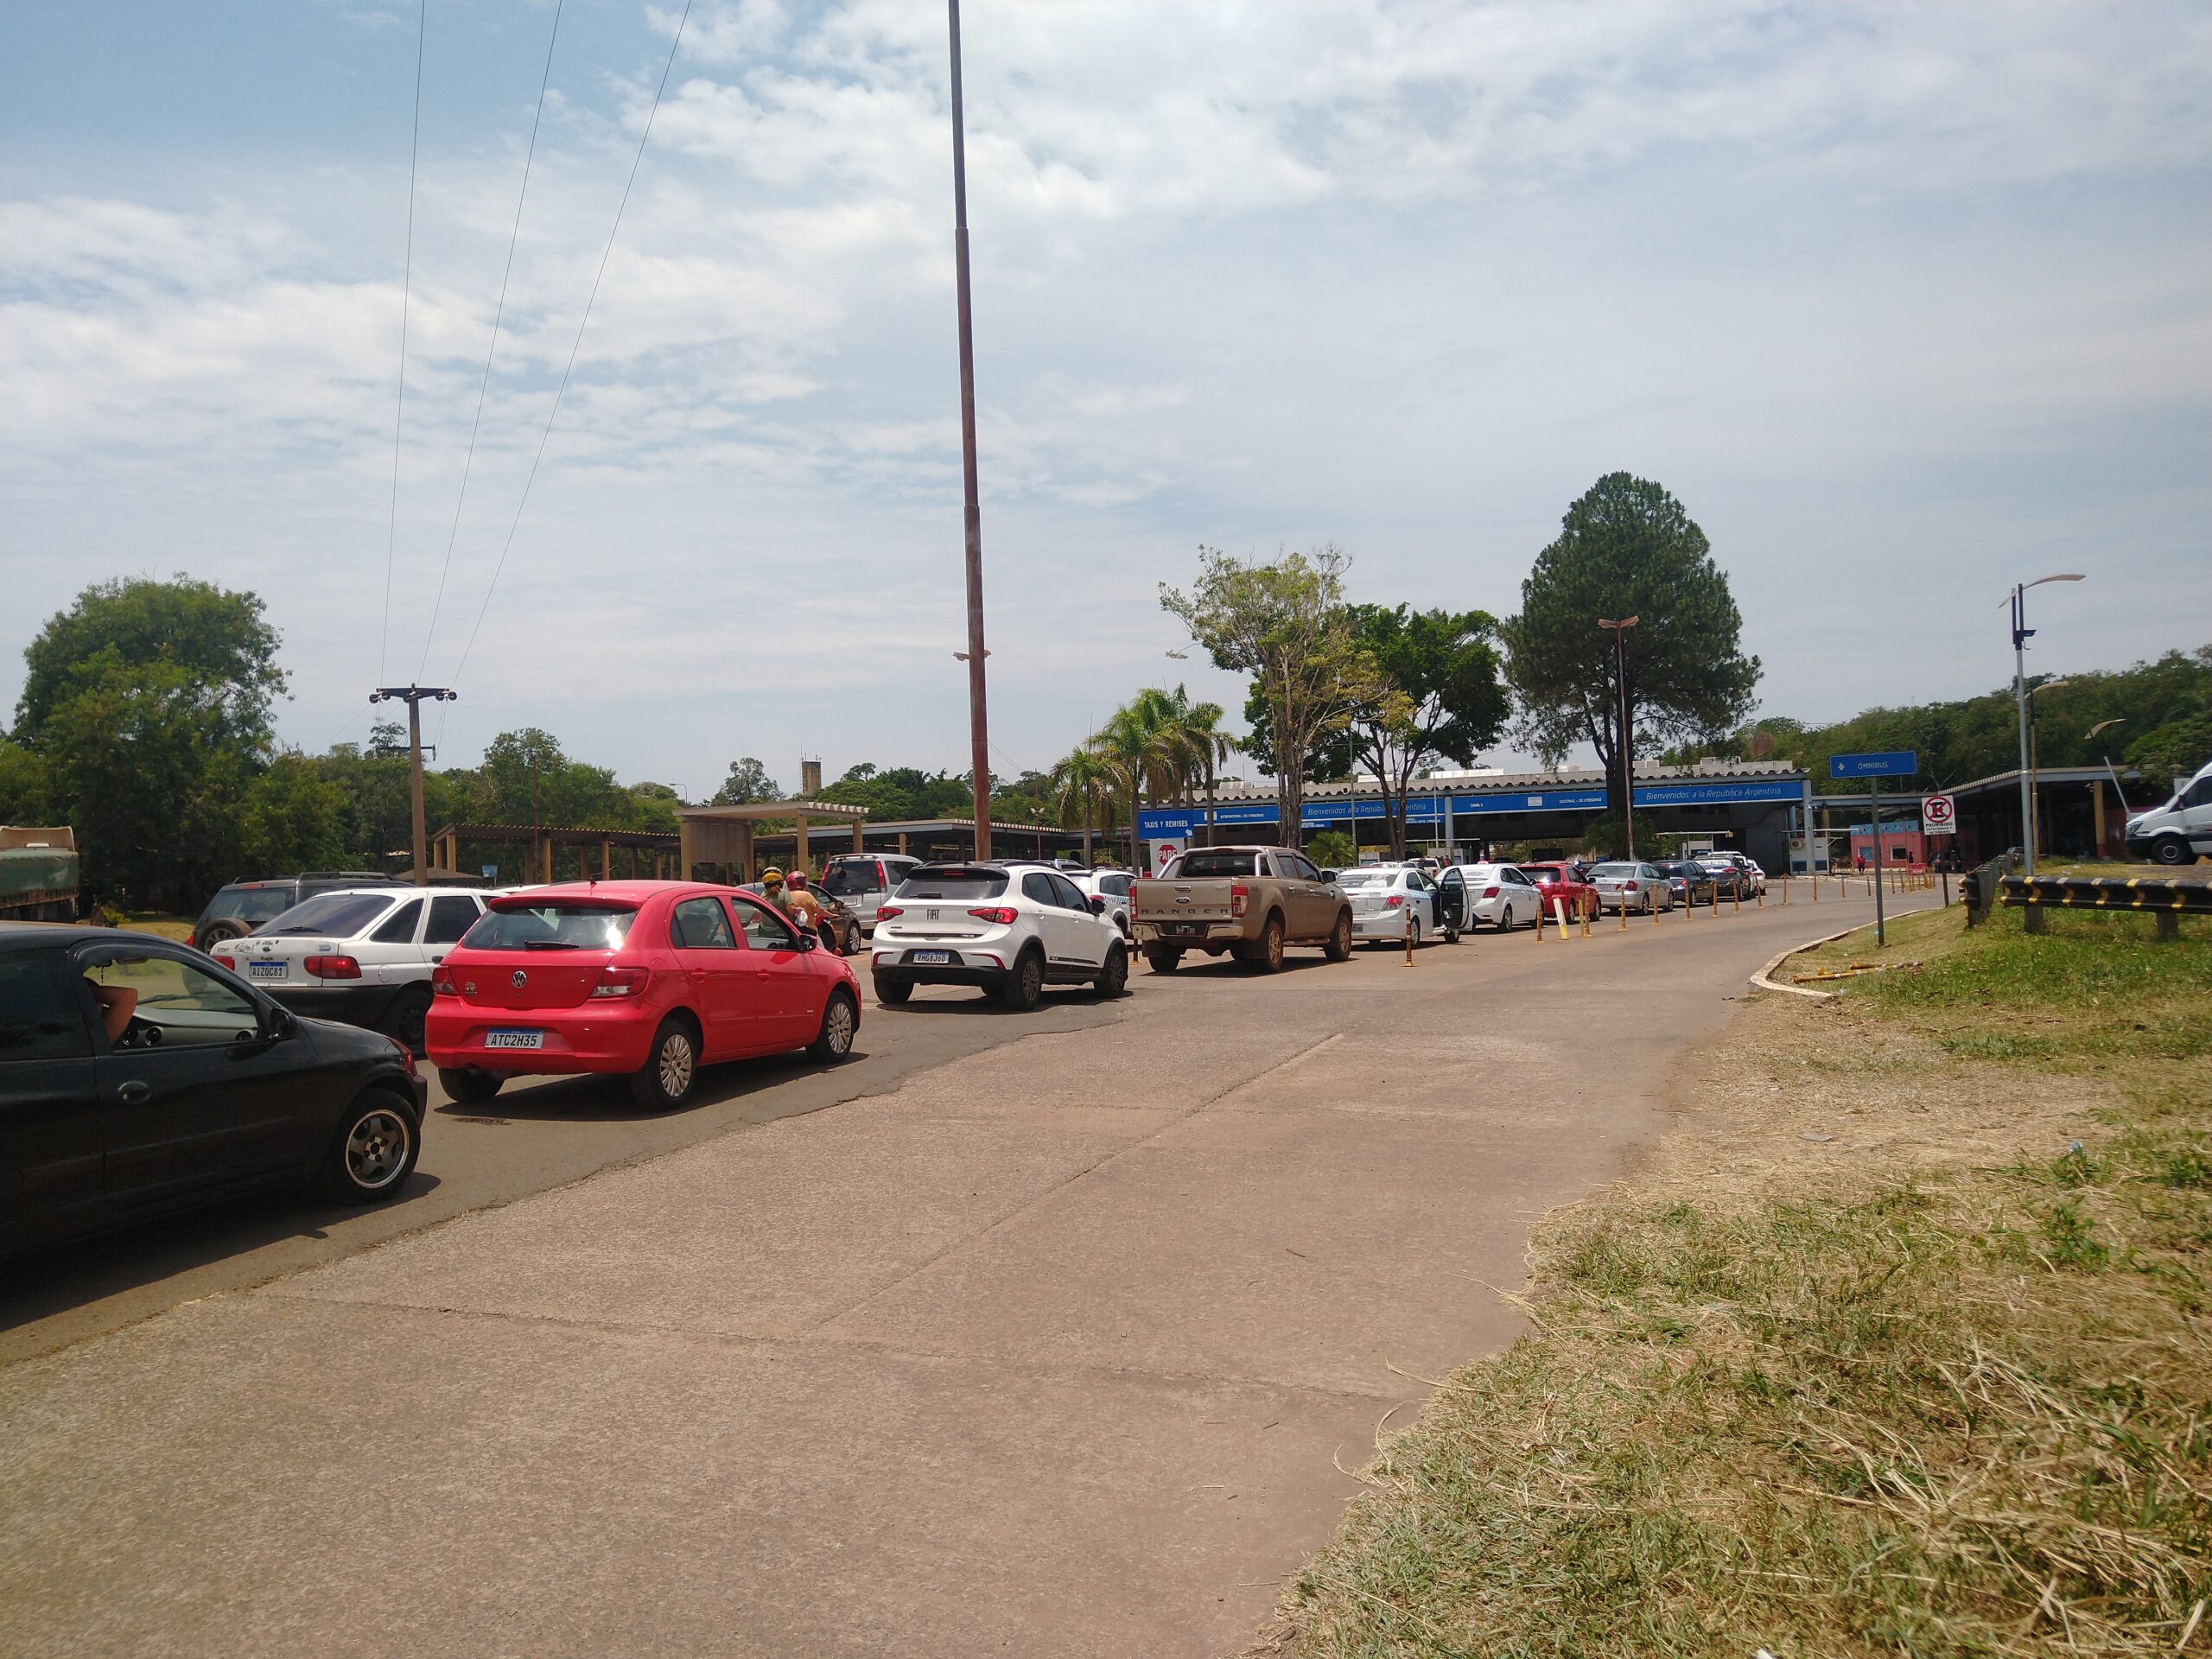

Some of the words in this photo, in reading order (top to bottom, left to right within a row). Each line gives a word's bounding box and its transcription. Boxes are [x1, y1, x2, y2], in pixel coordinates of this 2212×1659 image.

[1646, 791, 1689, 800] Bienvenidos
[1707, 788, 1742, 798] República
[1745, 787, 1781, 797] Argentina
[927, 909, 940, 920] FIAT
[490, 1035, 537, 1046] ATC2H35
